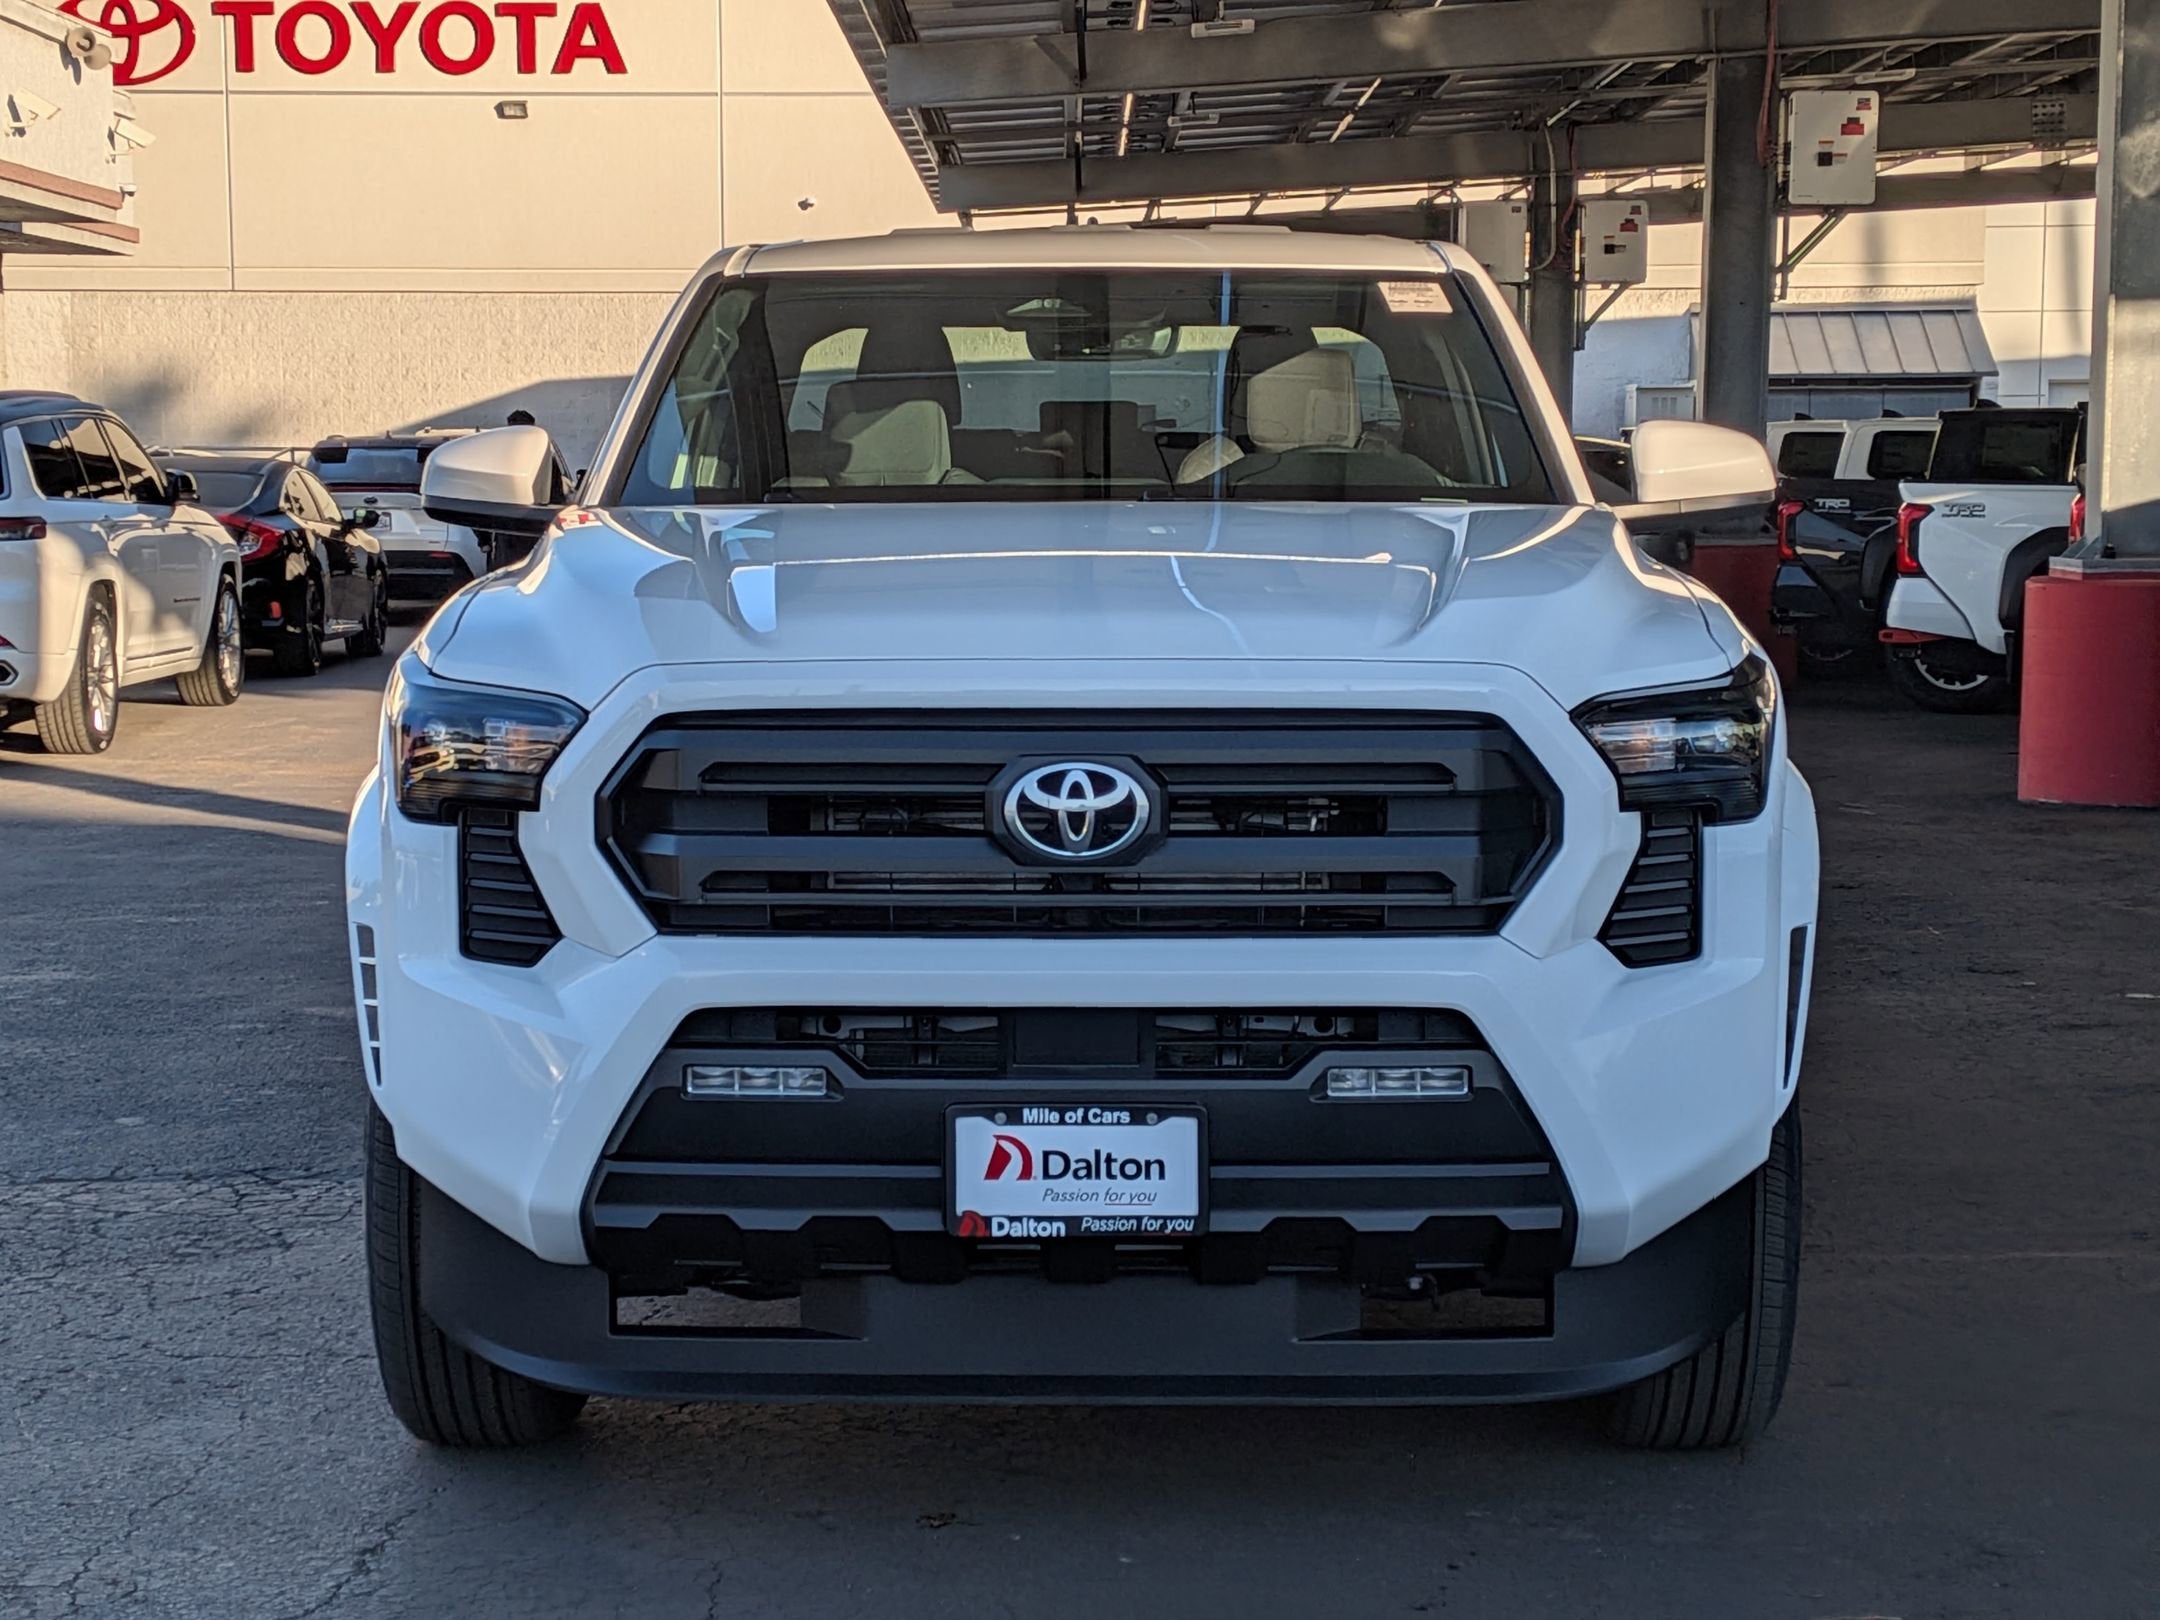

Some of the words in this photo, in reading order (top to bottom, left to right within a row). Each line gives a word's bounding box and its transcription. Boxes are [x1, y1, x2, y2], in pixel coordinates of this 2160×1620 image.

[211, 0, 628, 75] TOYOTA
[1022, 1107, 1060, 1124] Mile
[1064, 1107, 1084, 1124] of
[1087, 1107, 1131, 1124] Cars
[1041, 1149, 1166, 1181] Dalton
[1042, 1187, 1099, 1202] Passion
[1103, 1187, 1126, 1203] for
[1126, 1190, 1157, 1203] you
[991, 1216, 1066, 1238] Dalton
[1080, 1216, 1137, 1232] Passion
[1140, 1216, 1164, 1232] for
[1164, 1219, 1195, 1234] you
